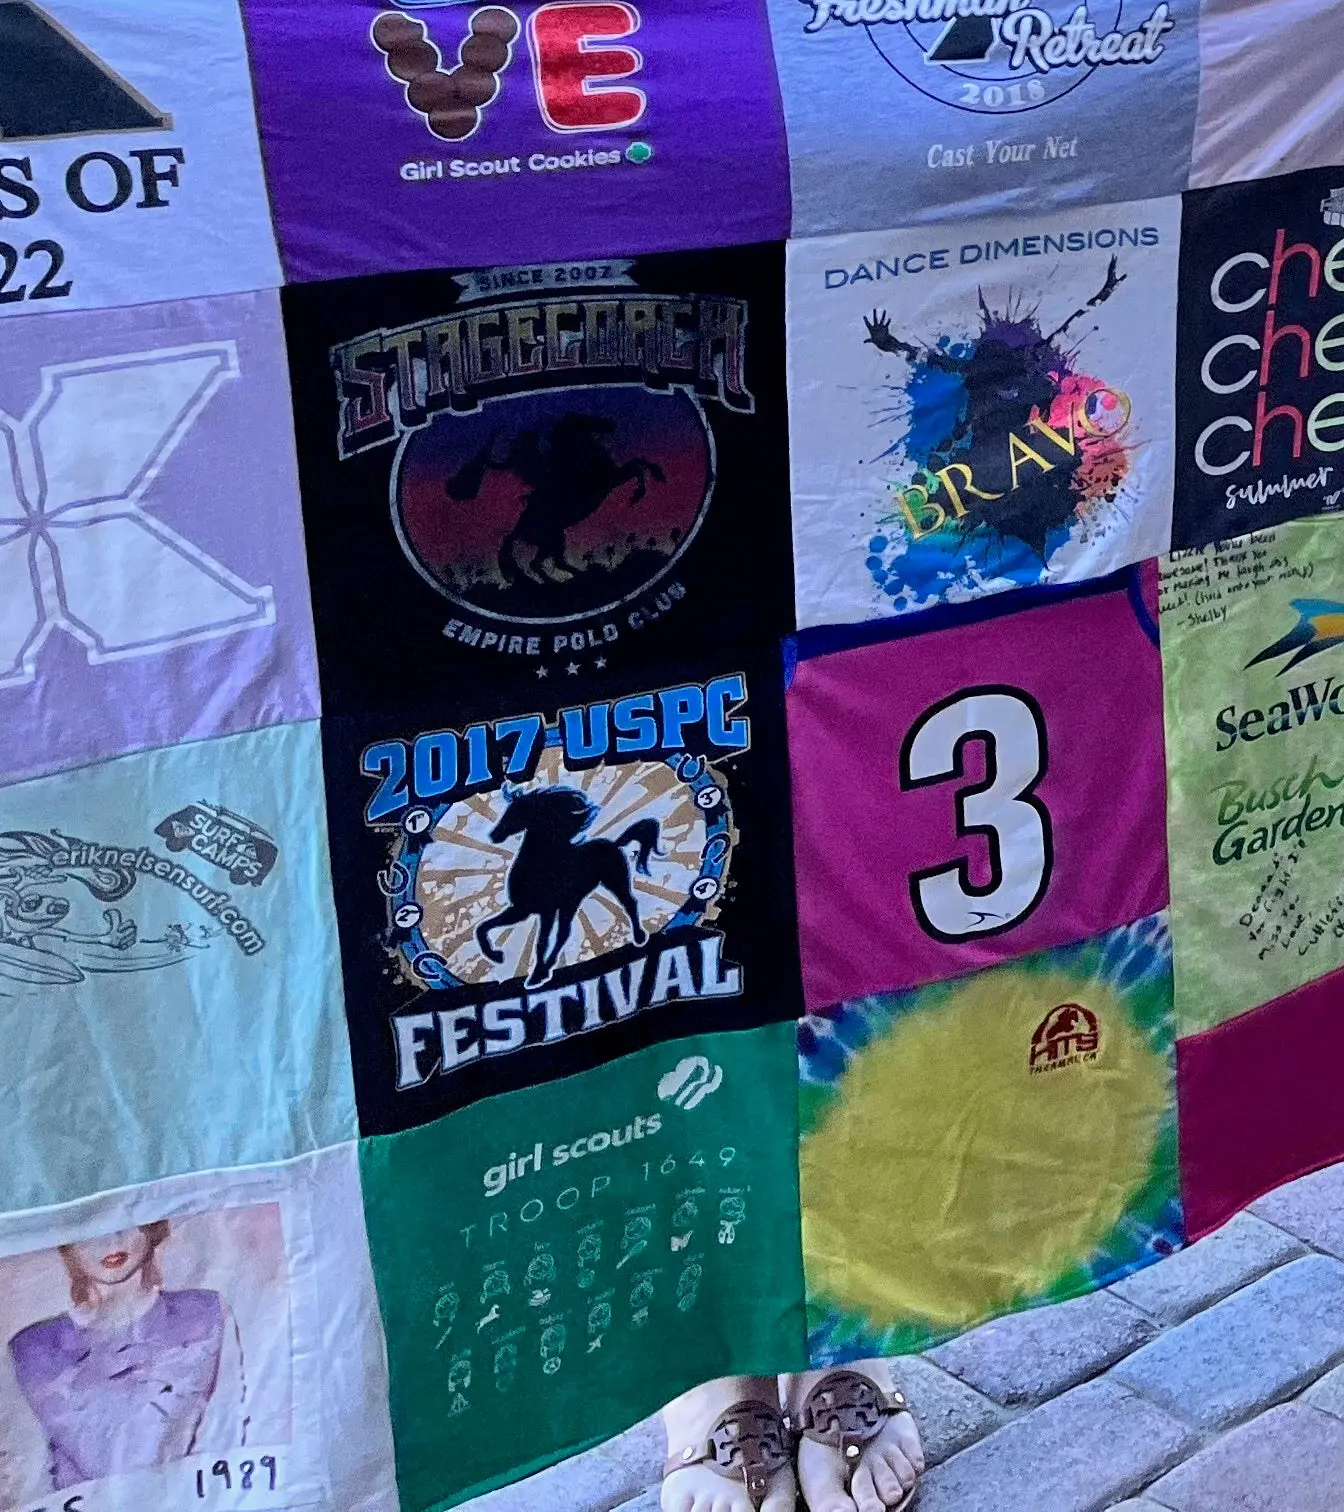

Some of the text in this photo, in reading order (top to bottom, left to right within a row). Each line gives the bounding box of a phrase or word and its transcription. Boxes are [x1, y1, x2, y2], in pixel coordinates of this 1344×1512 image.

[1002, 0, 1175, 75] Retreat
[64, 146, 187, 214] OF
[400, 146, 621, 182] Girl Scout Cookies
[926, 134, 1080, 171] Cast Your Net
[823, 226, 1160, 289] DANCE DIMENSIONS
[892, 385, 1132, 542] BRAVO
[441, 619, 541, 655] EMPIRE
[552, 622, 620, 654] POLO
[362, 671, 752, 825] 2017 USPC
[188, 812, 245, 847] SURF
[900, 683, 1053, 946] 3
[191, 834, 263, 880] CAMPS
[50, 844, 266, 956] eriknelsensurf.com
[395, 936, 742, 1090] FESTIVAL
[1029, 1031, 1099, 1066] HITS
[482, 1111, 663, 1198] girl scouts
[458, 1174, 612, 1249] TROOP
[196, 1454, 277, 1499] 1989
